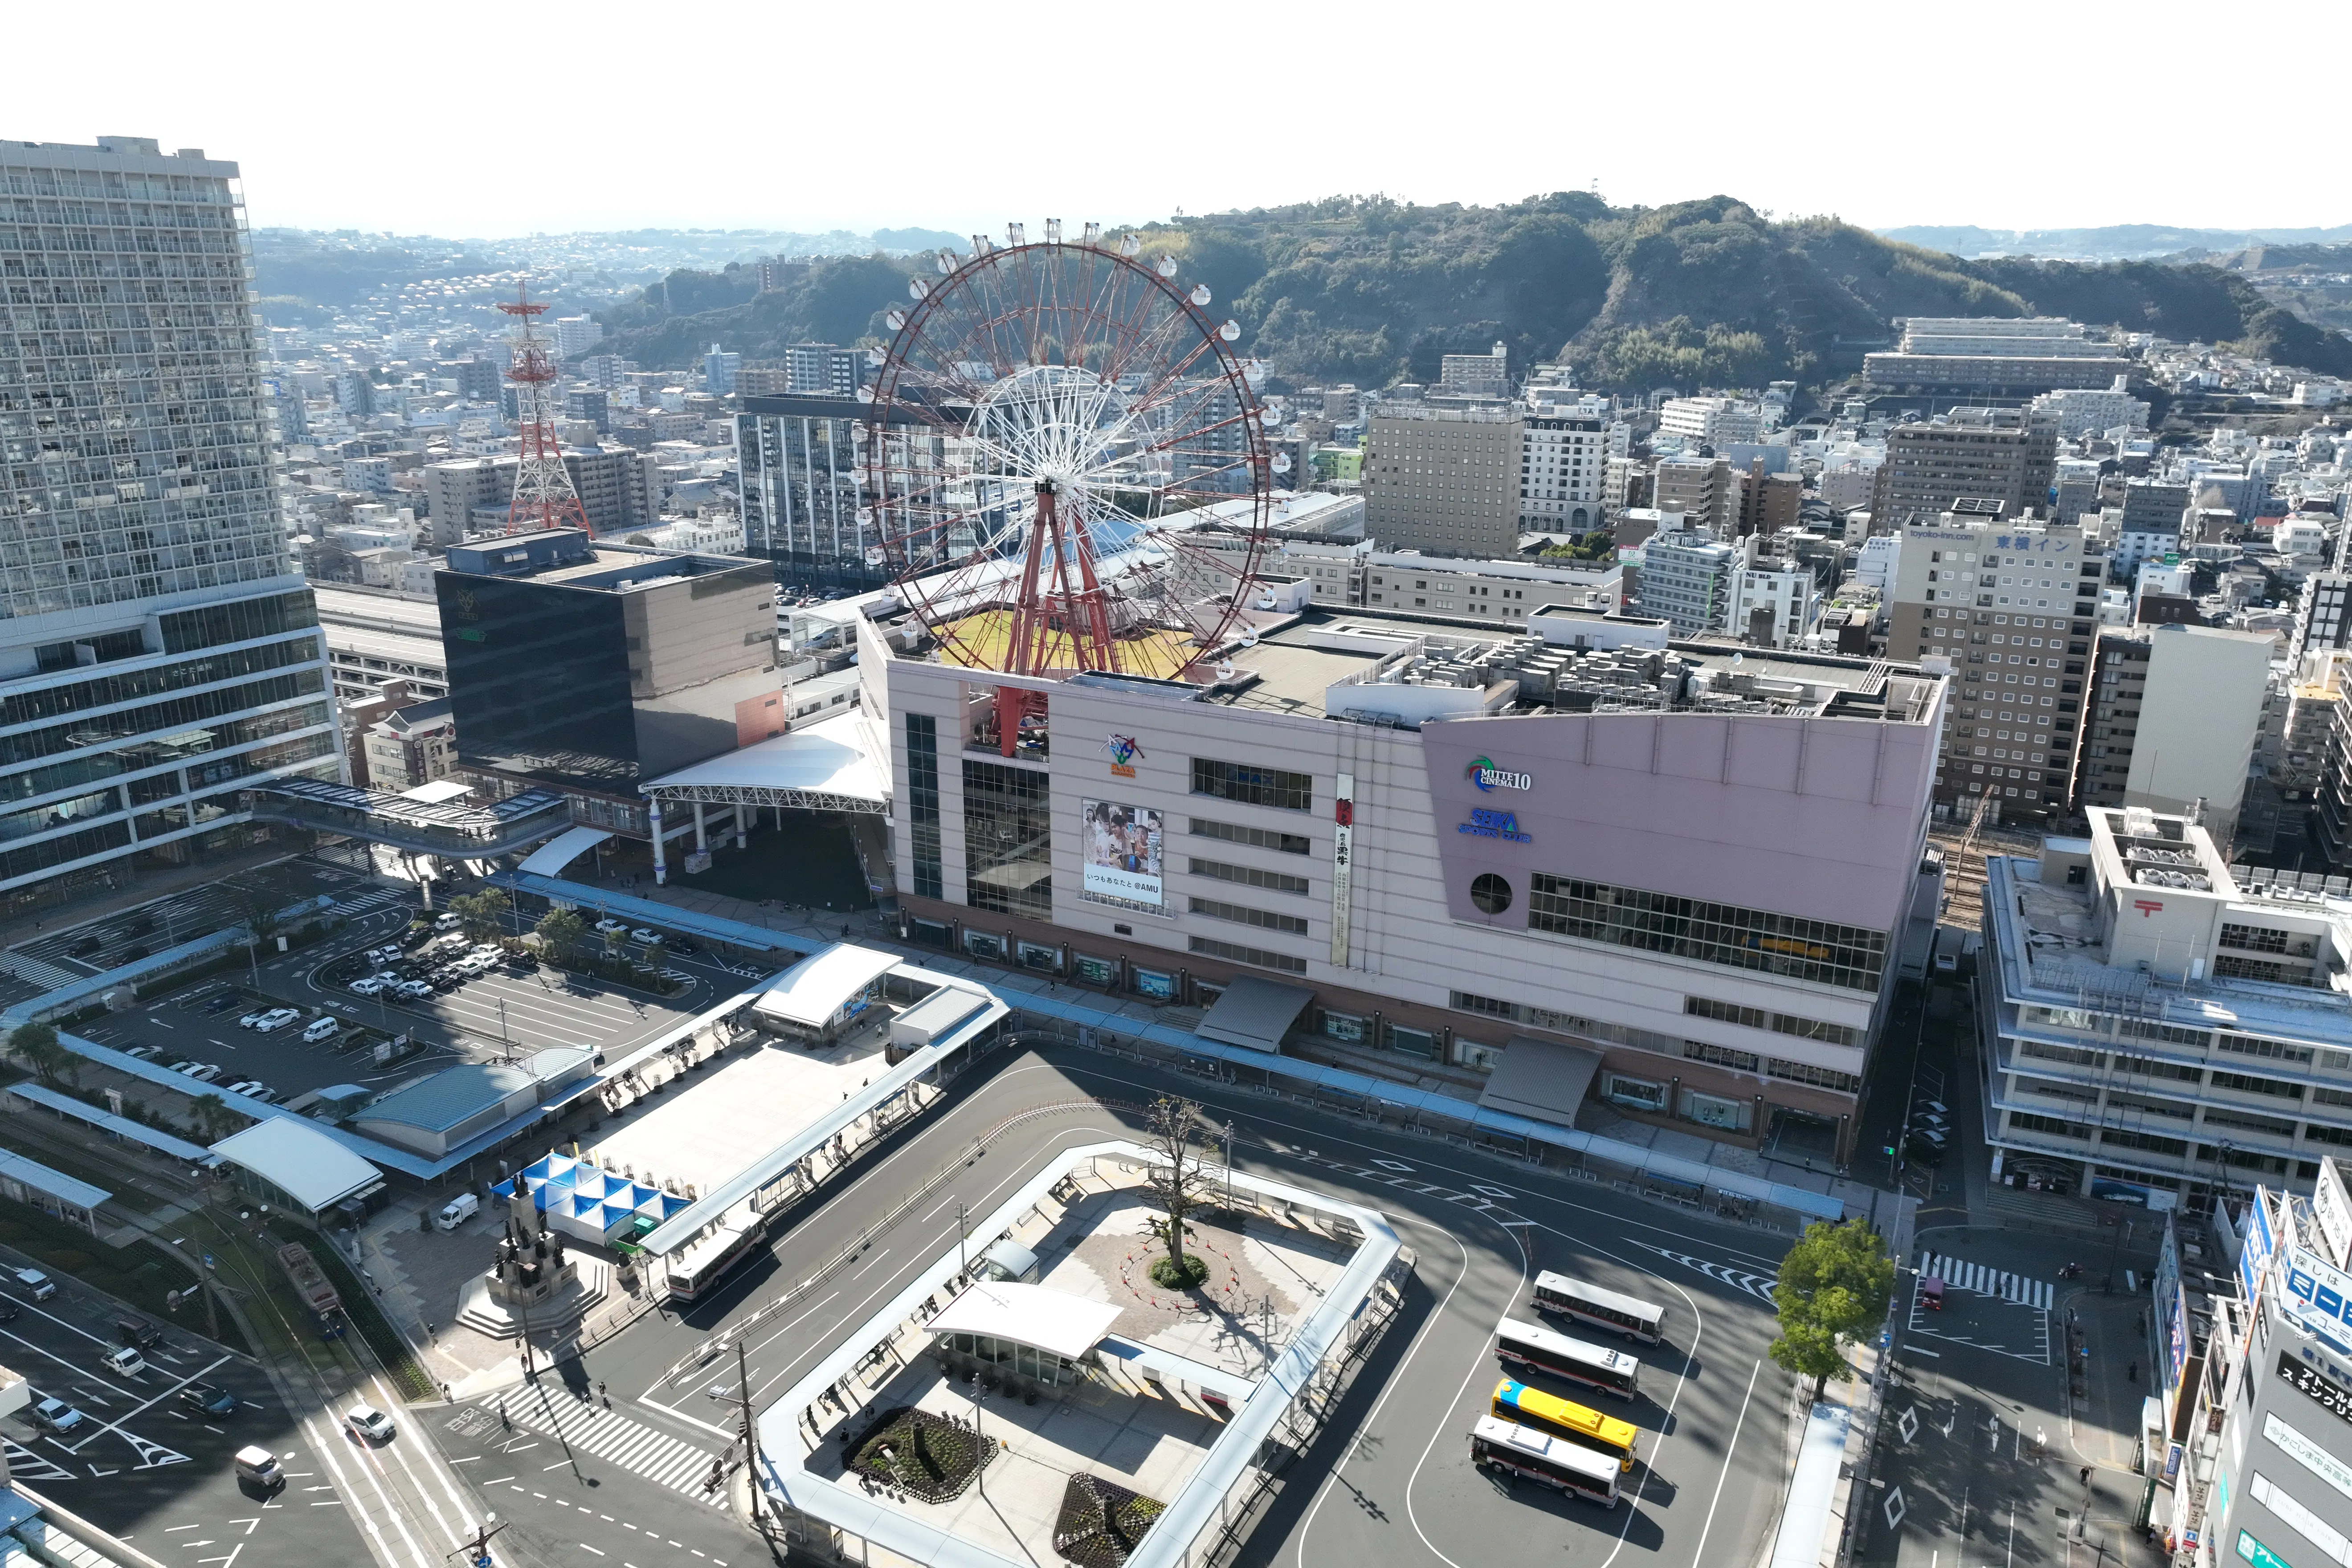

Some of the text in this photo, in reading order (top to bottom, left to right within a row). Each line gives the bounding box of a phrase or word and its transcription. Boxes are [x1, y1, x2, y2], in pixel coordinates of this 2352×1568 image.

[1910, 530, 1974, 541] toyoko-inn.com
[1995, 535, 2070, 552] 東横イン
[1111, 764, 1135, 774] PLAZA
[1481, 768, 1514, 781] MITTE
[1480, 778, 1513, 788] CINEMA
[1512, 772, 1531, 791] 10
[1458, 825, 1531, 844] SPORTS CLUB
[1087, 874, 1158, 893] いつもあなたと @AMU
[2294, 1254, 2339, 1286] 探しは
[2317, 1316, 2352, 1344] ユーミ
[2168, 1447, 2180, 1473] LAWSON
